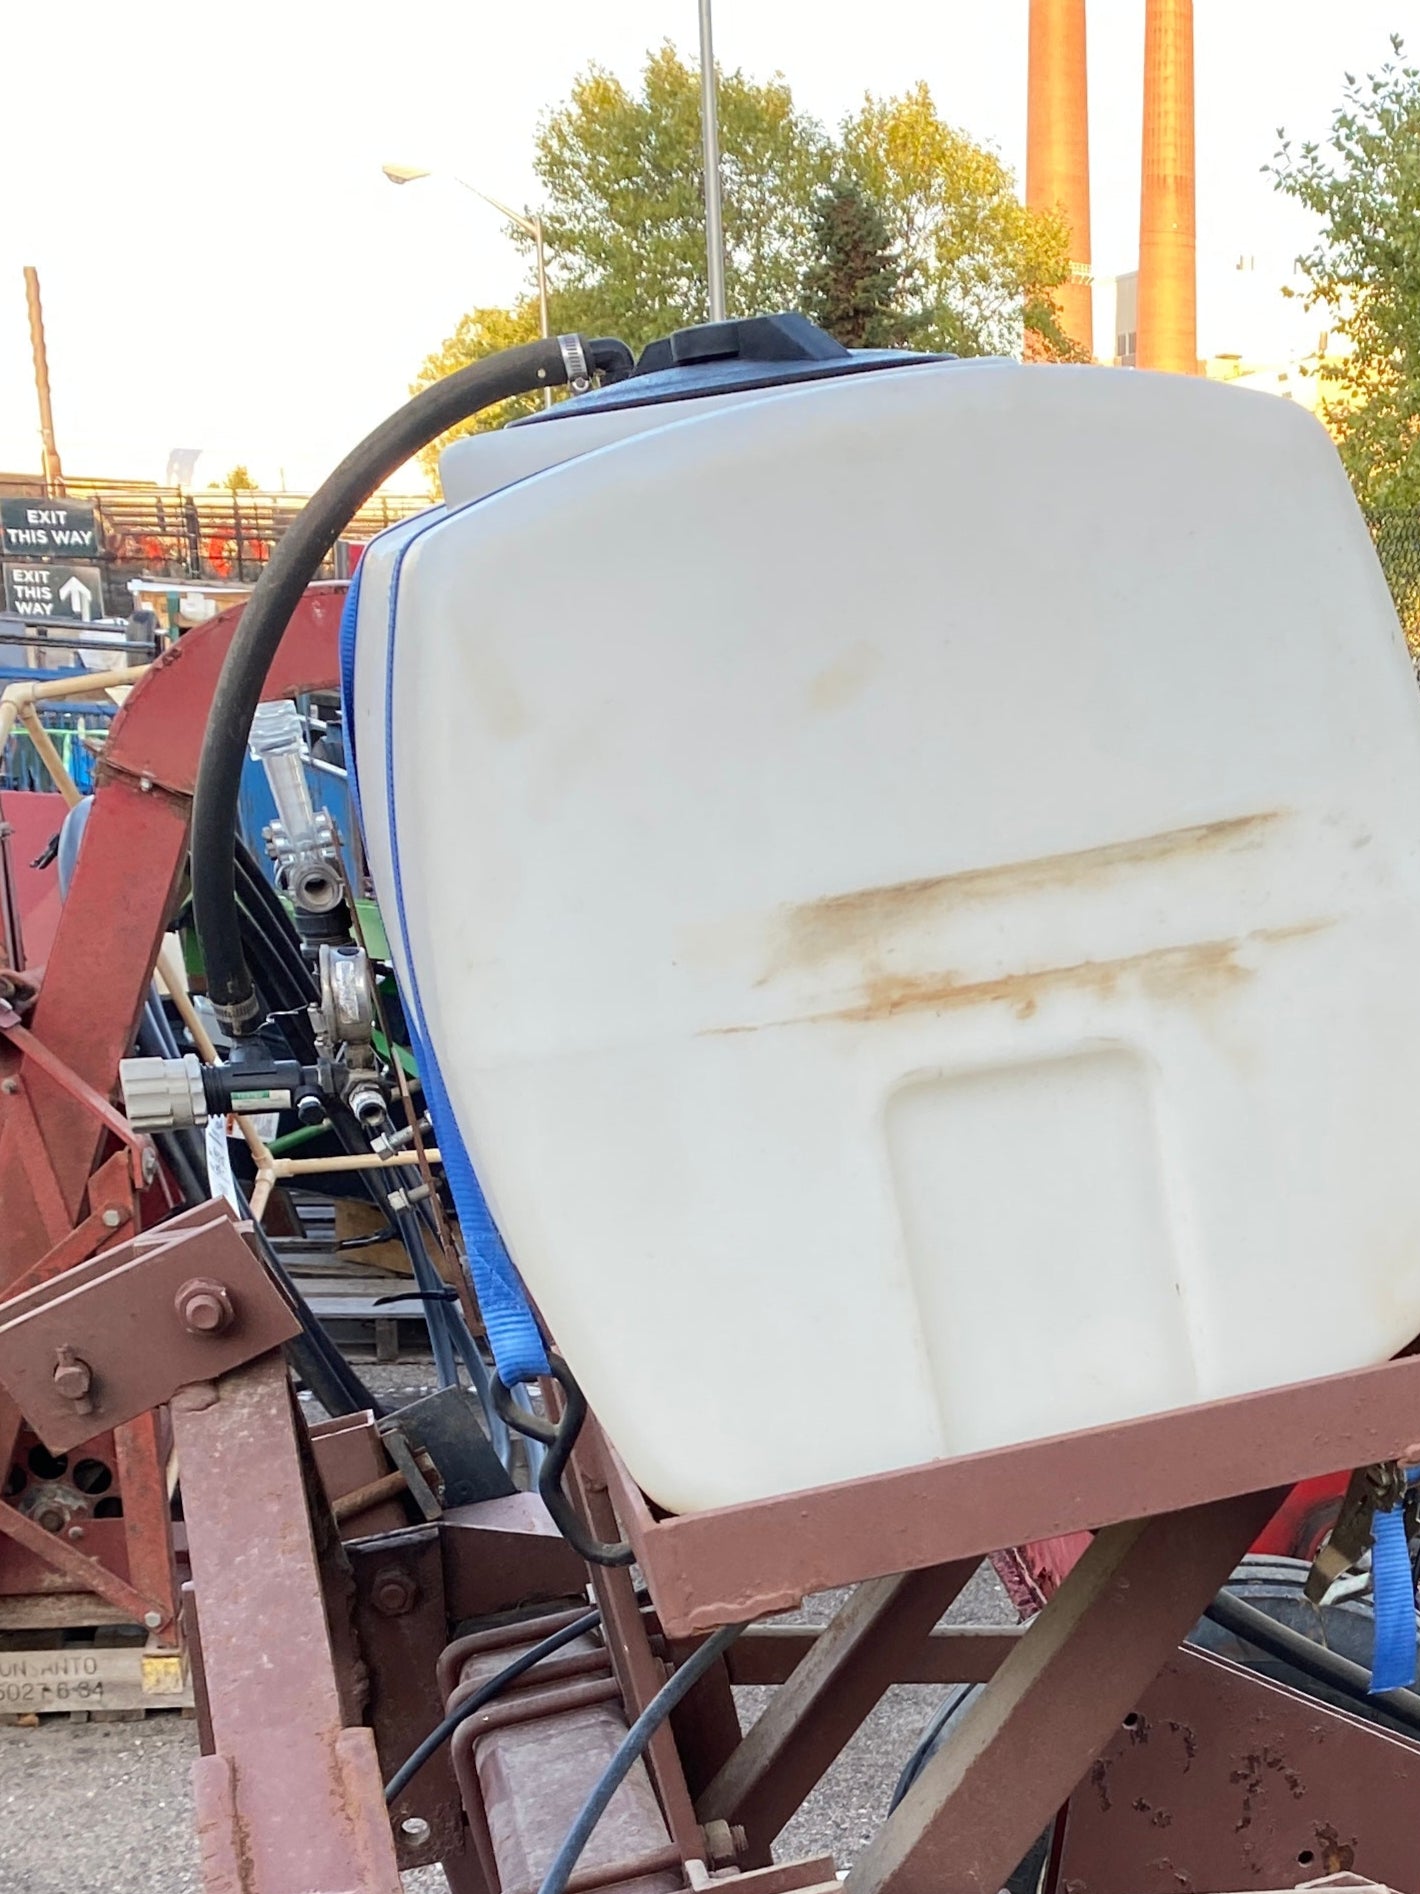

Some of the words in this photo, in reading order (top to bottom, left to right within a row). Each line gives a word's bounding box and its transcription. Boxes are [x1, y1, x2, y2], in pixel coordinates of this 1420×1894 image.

[26, 509, 67, 525] EXIT
[6, 529, 48, 544] THIS
[51, 530, 92, 546] WAY
[12, 569, 50, 584] EXIT
[13, 585, 52, 600] THIS
[15, 601, 53, 615] WAY
